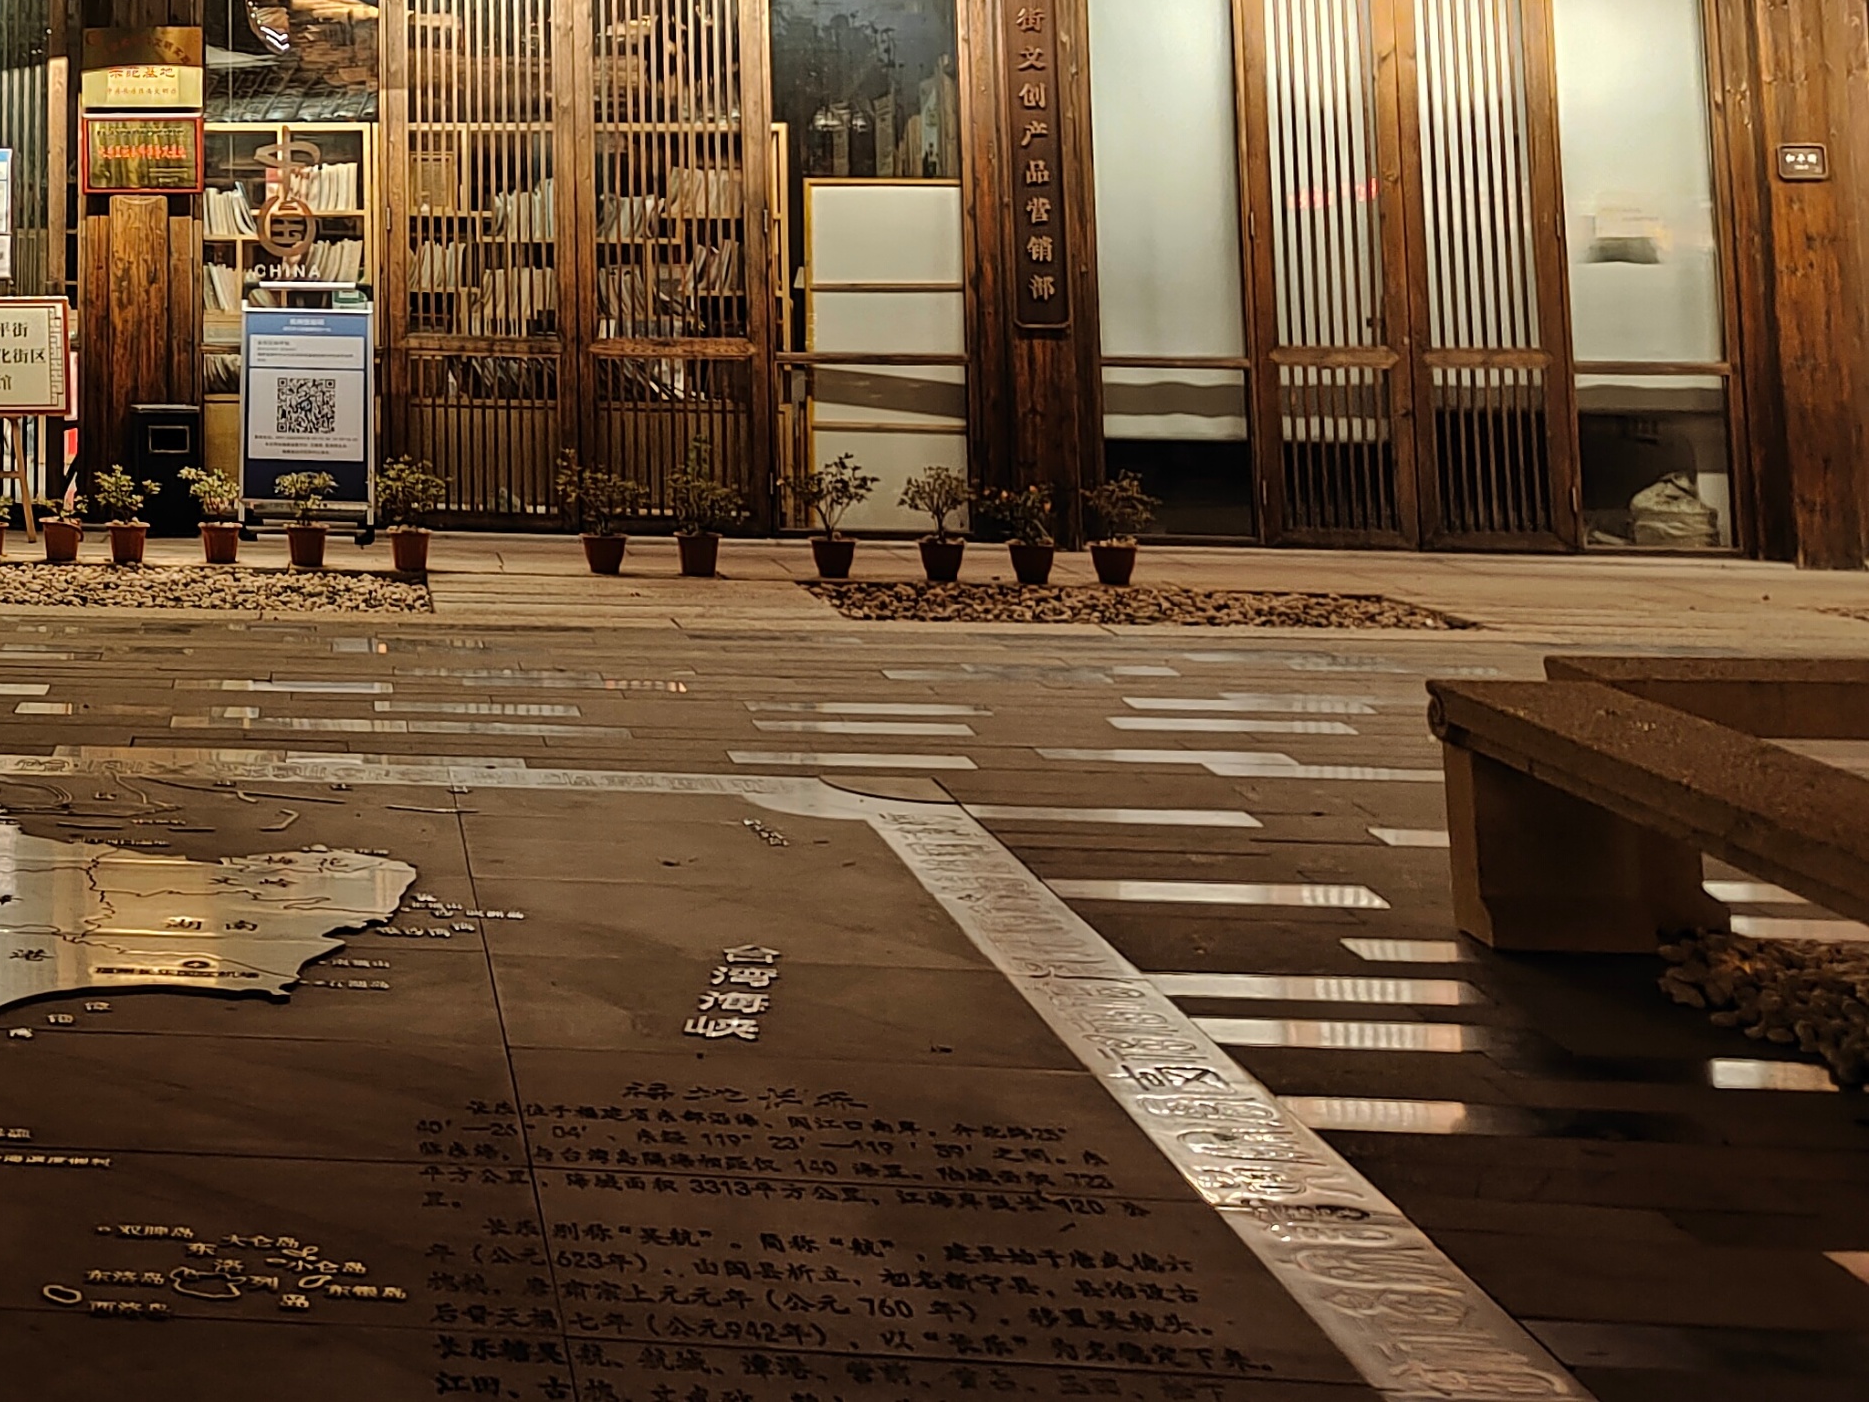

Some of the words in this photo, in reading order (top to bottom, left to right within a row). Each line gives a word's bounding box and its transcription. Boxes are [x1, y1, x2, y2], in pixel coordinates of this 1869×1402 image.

[108, 66, 176, 79] 示范基地
[253, 264, 322, 279] CHINA
[683, 944, 781, 1041] 台湾海峡
